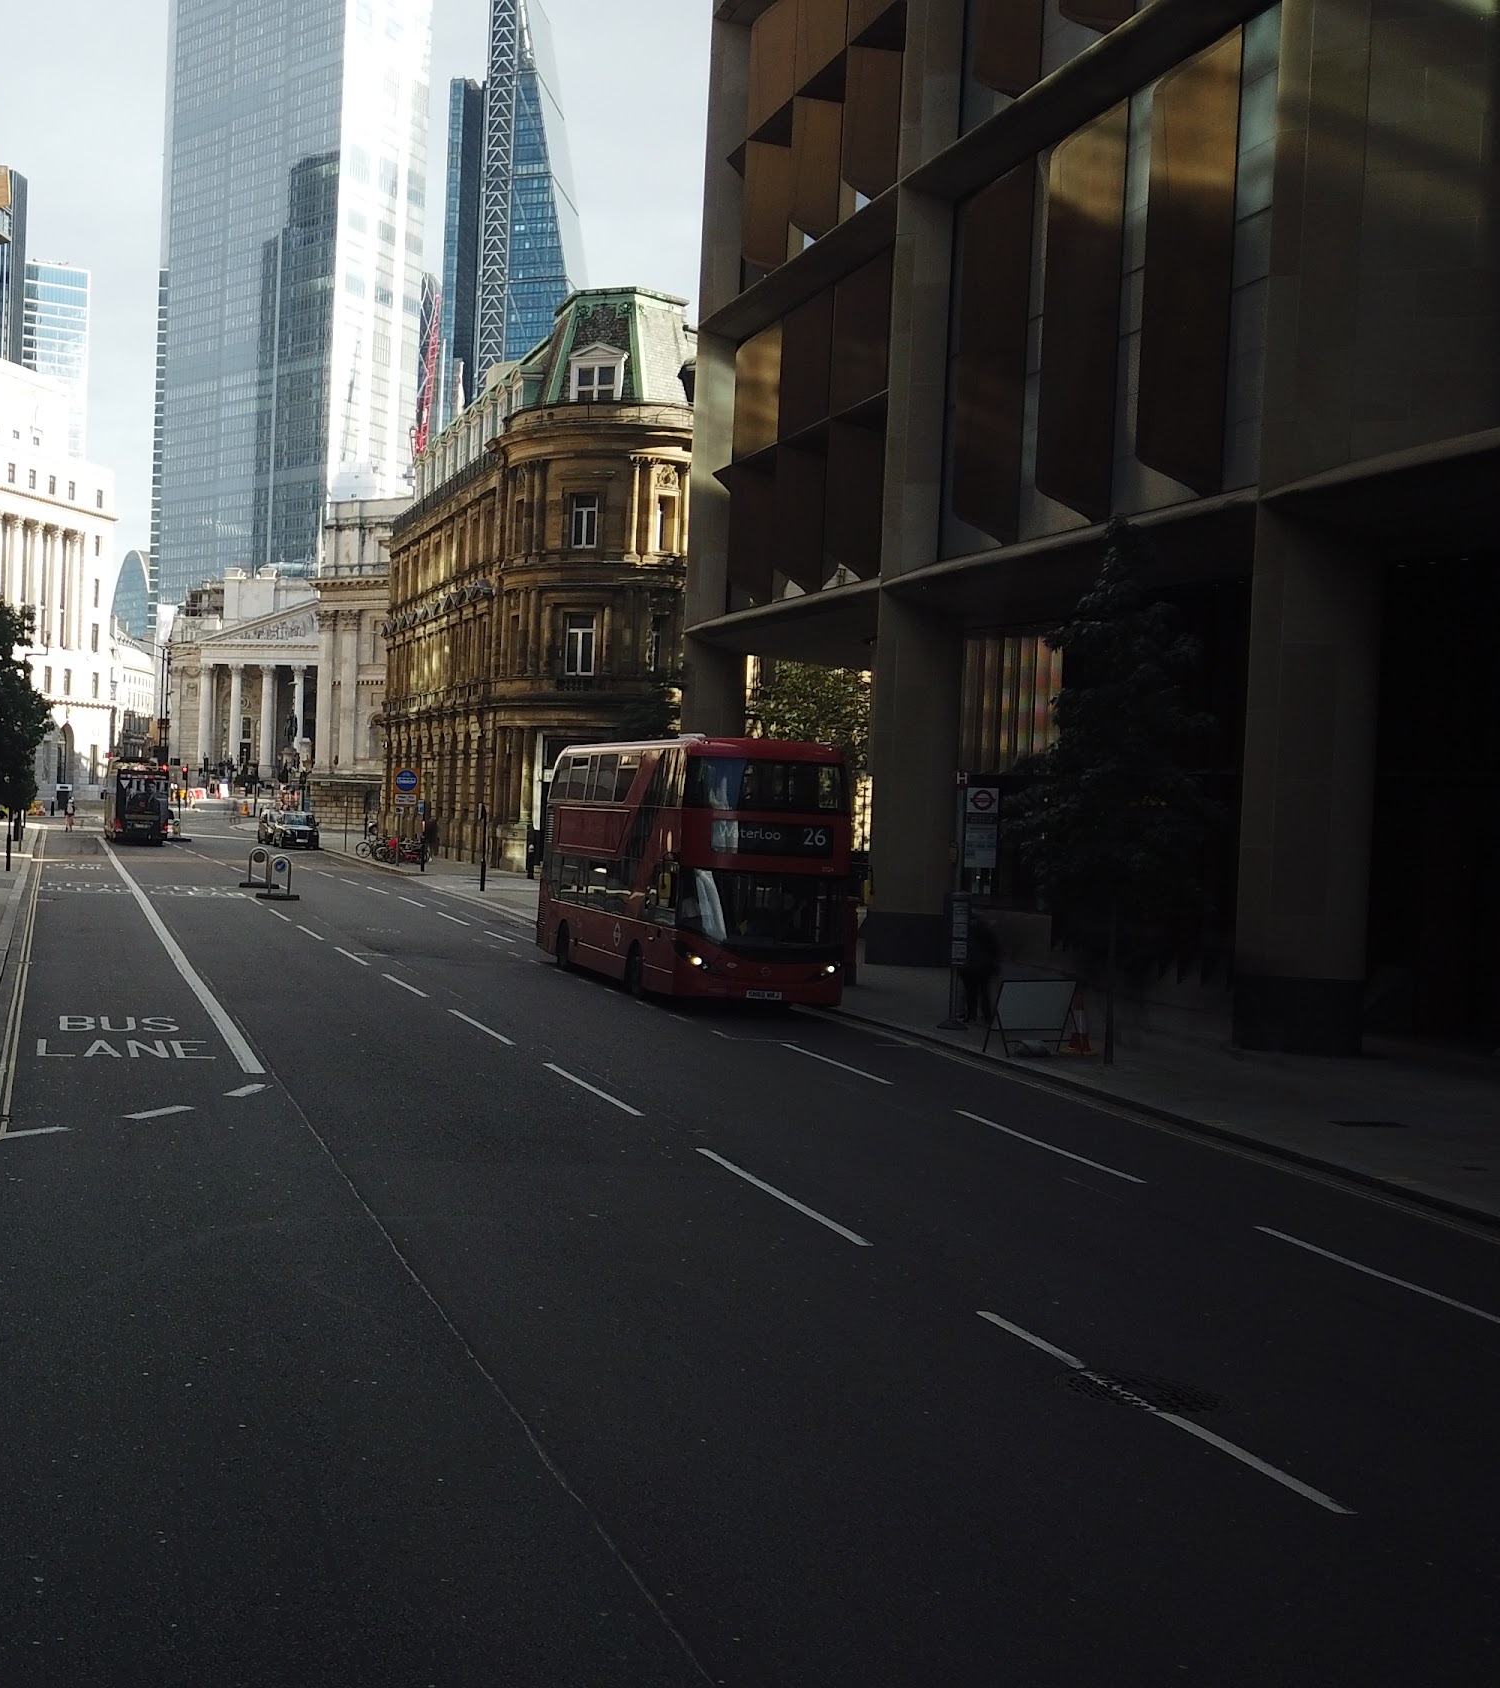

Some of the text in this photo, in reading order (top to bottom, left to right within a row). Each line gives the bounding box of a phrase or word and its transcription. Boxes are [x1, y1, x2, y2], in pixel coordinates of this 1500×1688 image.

[956, 771, 969, 785] H
[719, 824, 827, 847] Waterloo 26
[57, 1015, 181, 1033] BUS
[35, 1038, 217, 1060] LANE
